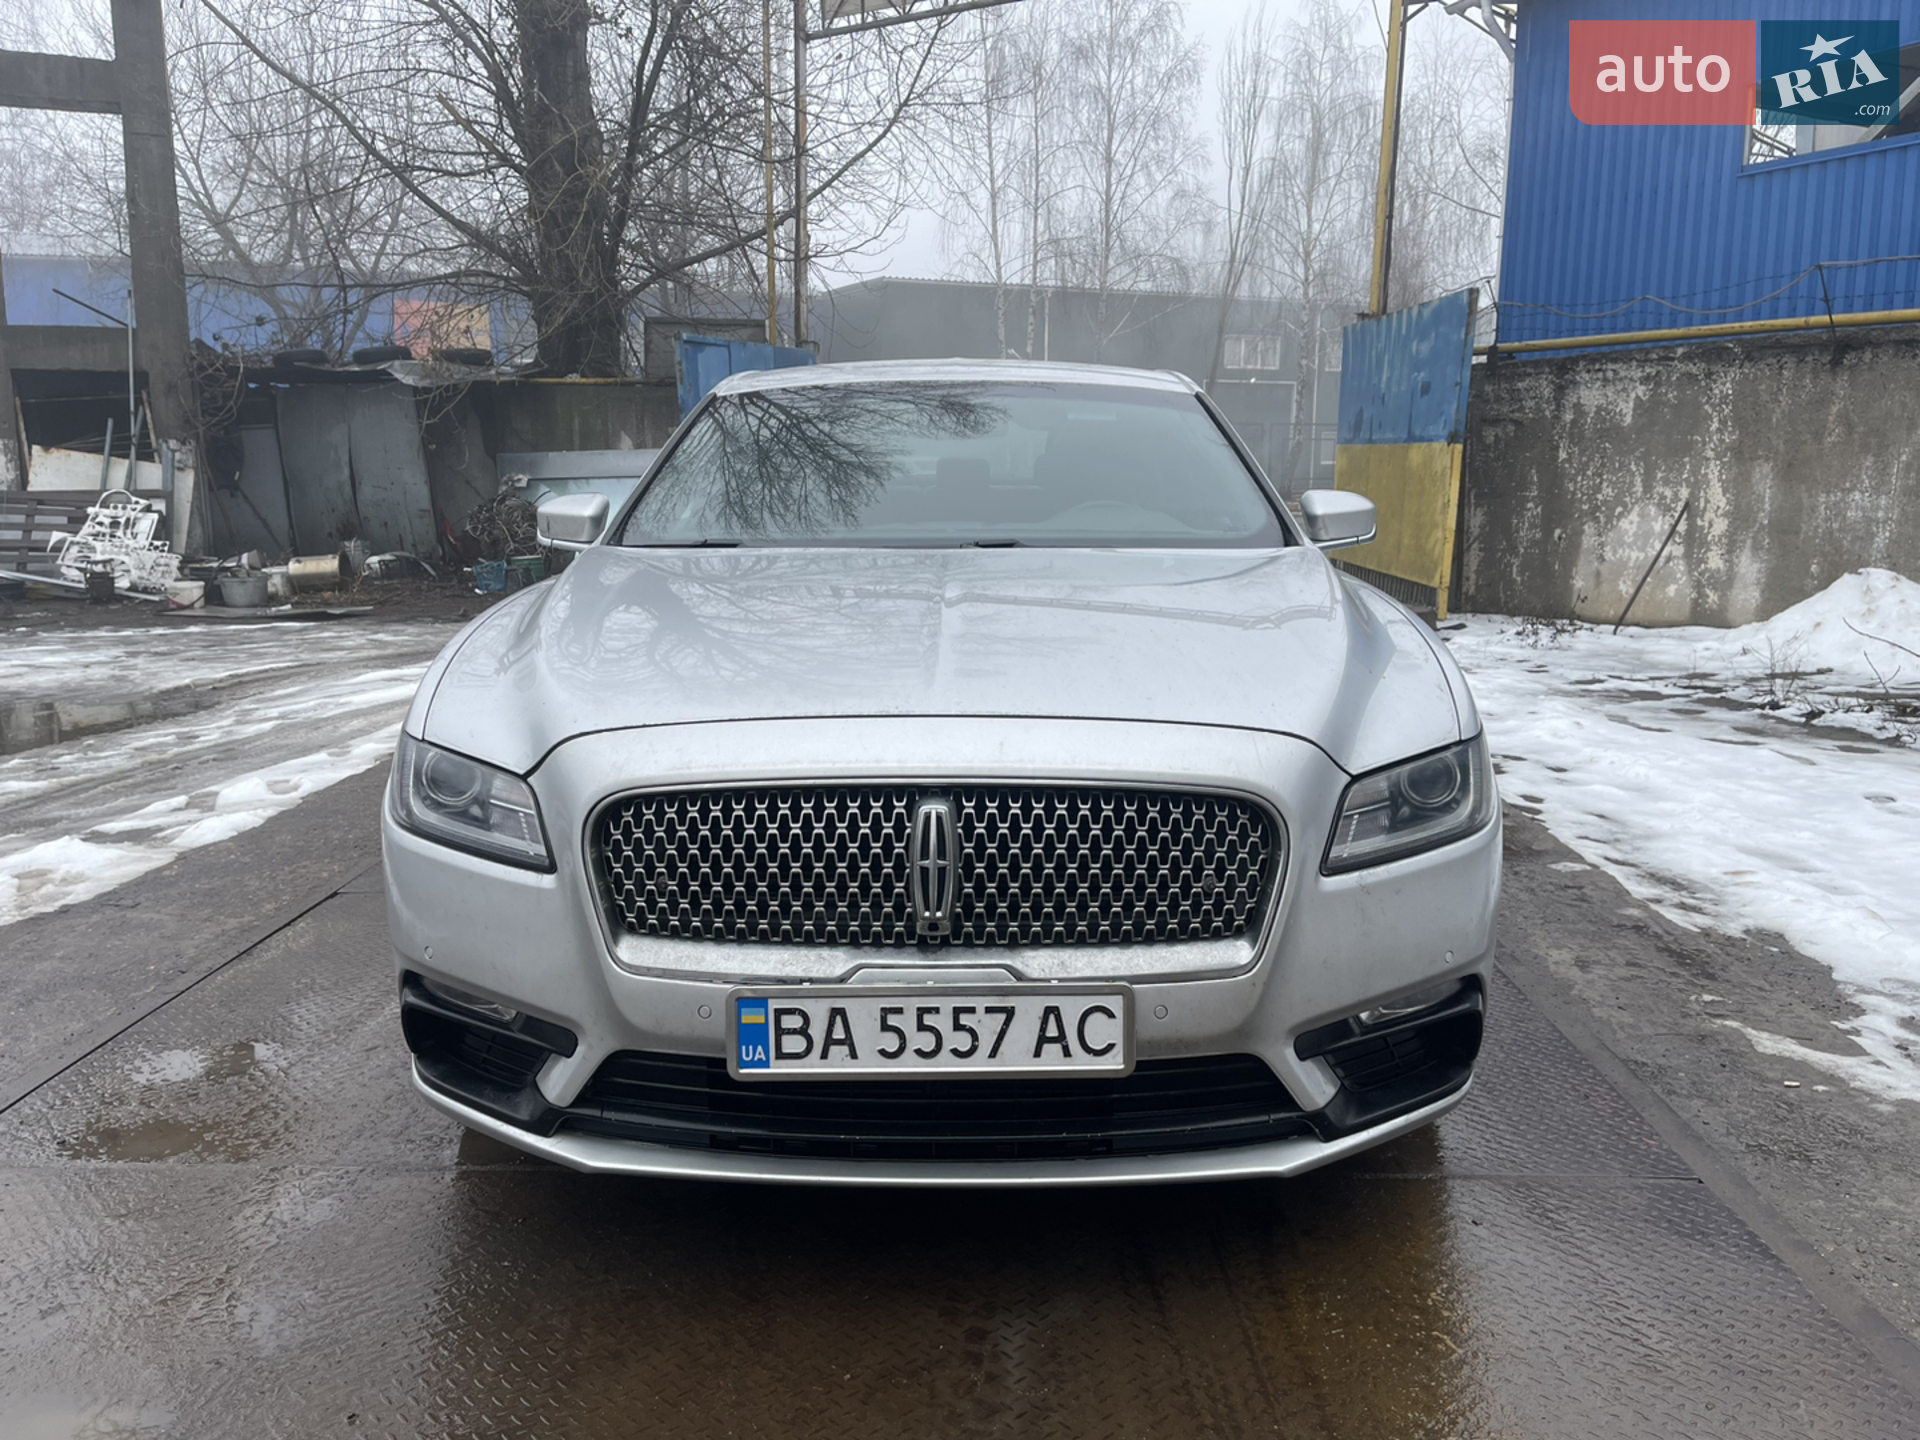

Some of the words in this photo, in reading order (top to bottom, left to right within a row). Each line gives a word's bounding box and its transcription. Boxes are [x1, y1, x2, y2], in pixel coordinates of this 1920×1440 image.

[773, 1006, 859, 1061] BA
[876, 1005, 1016, 1060] 5557
[1032, 1004, 1118, 1058] AC
[741, 1044, 766, 1062] UA
